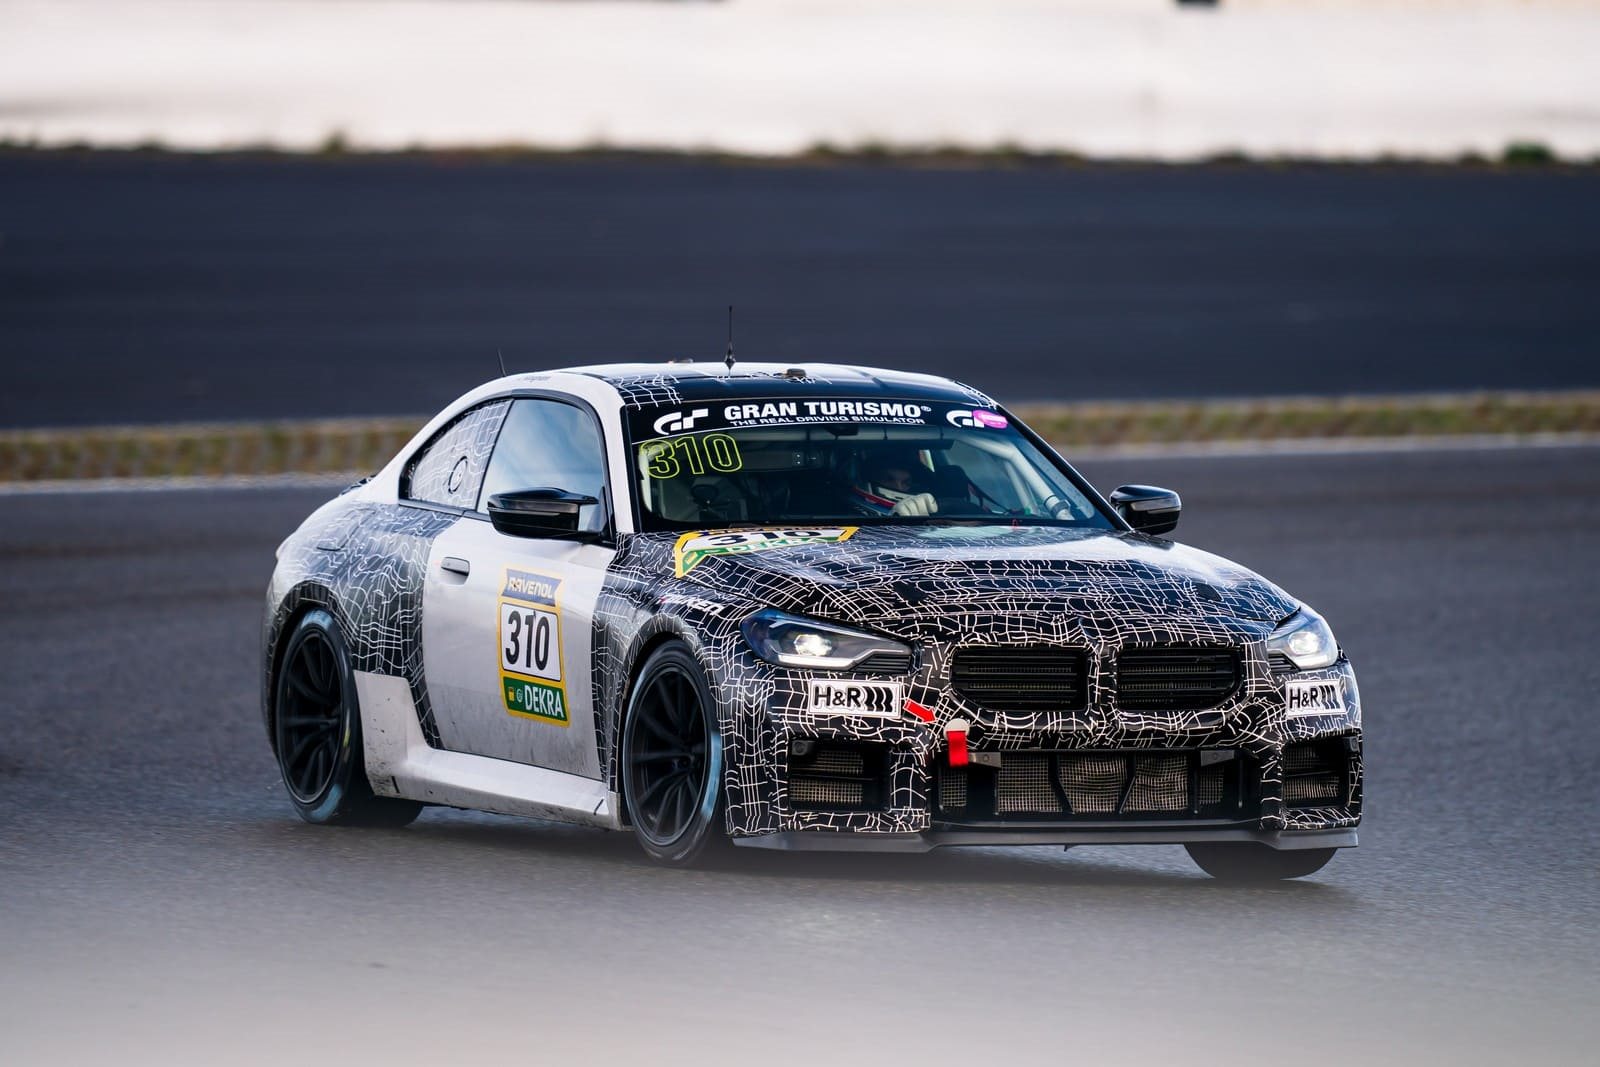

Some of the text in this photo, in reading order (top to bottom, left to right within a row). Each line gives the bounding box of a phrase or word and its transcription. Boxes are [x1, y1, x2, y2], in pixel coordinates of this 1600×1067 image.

[723, 402, 798, 420] GRAN
[729, 419, 757, 427] THE
[796, 415, 849, 423] DRIVING
[850, 415, 926, 425] SIMULATOR
[639, 433, 743, 479] 310
[707, 530, 822, 546] 310
[507, 577, 554, 599] RAVENOL
[505, 610, 550, 671] 310
[524, 684, 565, 719] DEKRA
[813, 685, 862, 708] H&R
[1288, 687, 1321, 709] H&R
